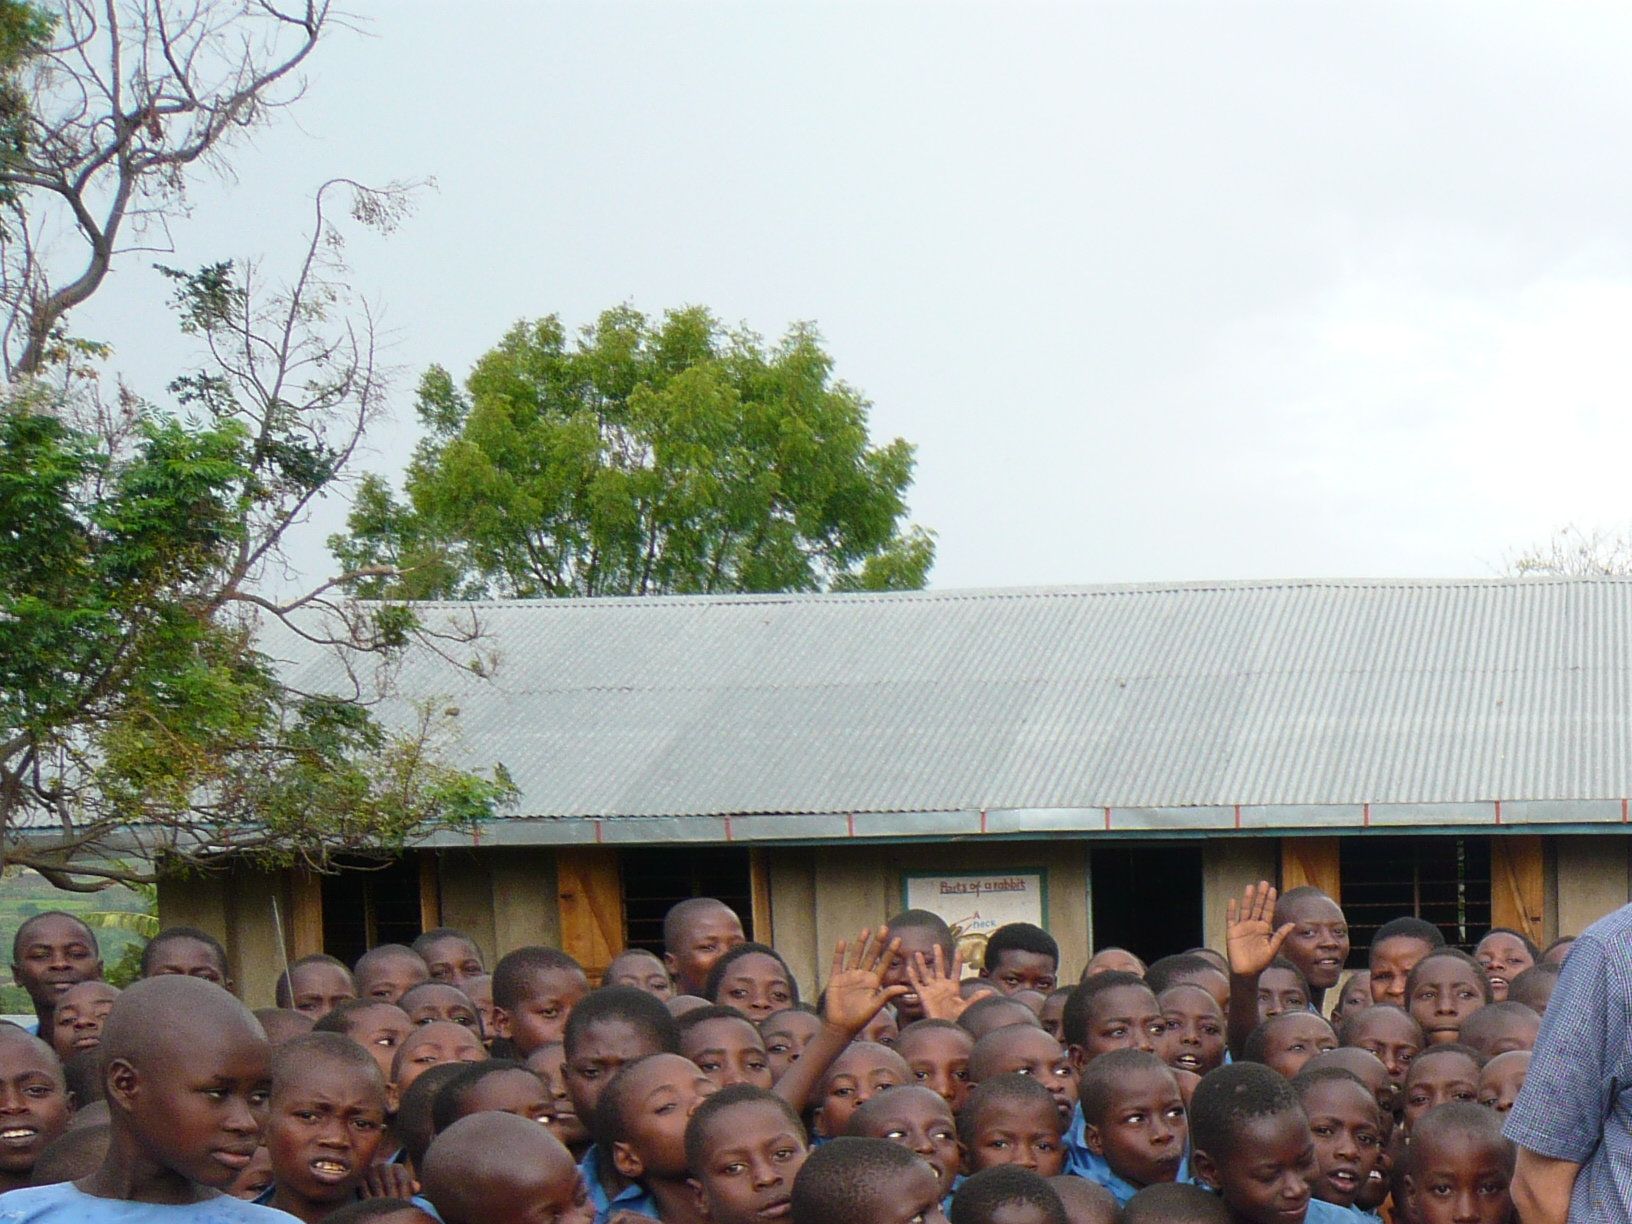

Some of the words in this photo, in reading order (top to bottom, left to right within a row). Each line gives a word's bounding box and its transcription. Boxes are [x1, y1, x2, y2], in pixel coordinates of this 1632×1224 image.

[940, 881, 967, 892] Parts
[970, 880, 982, 897] of
[984, 882, 992, 890] a
[994, 878, 1026, 890] rabbit
[973, 919, 997, 929] neck
